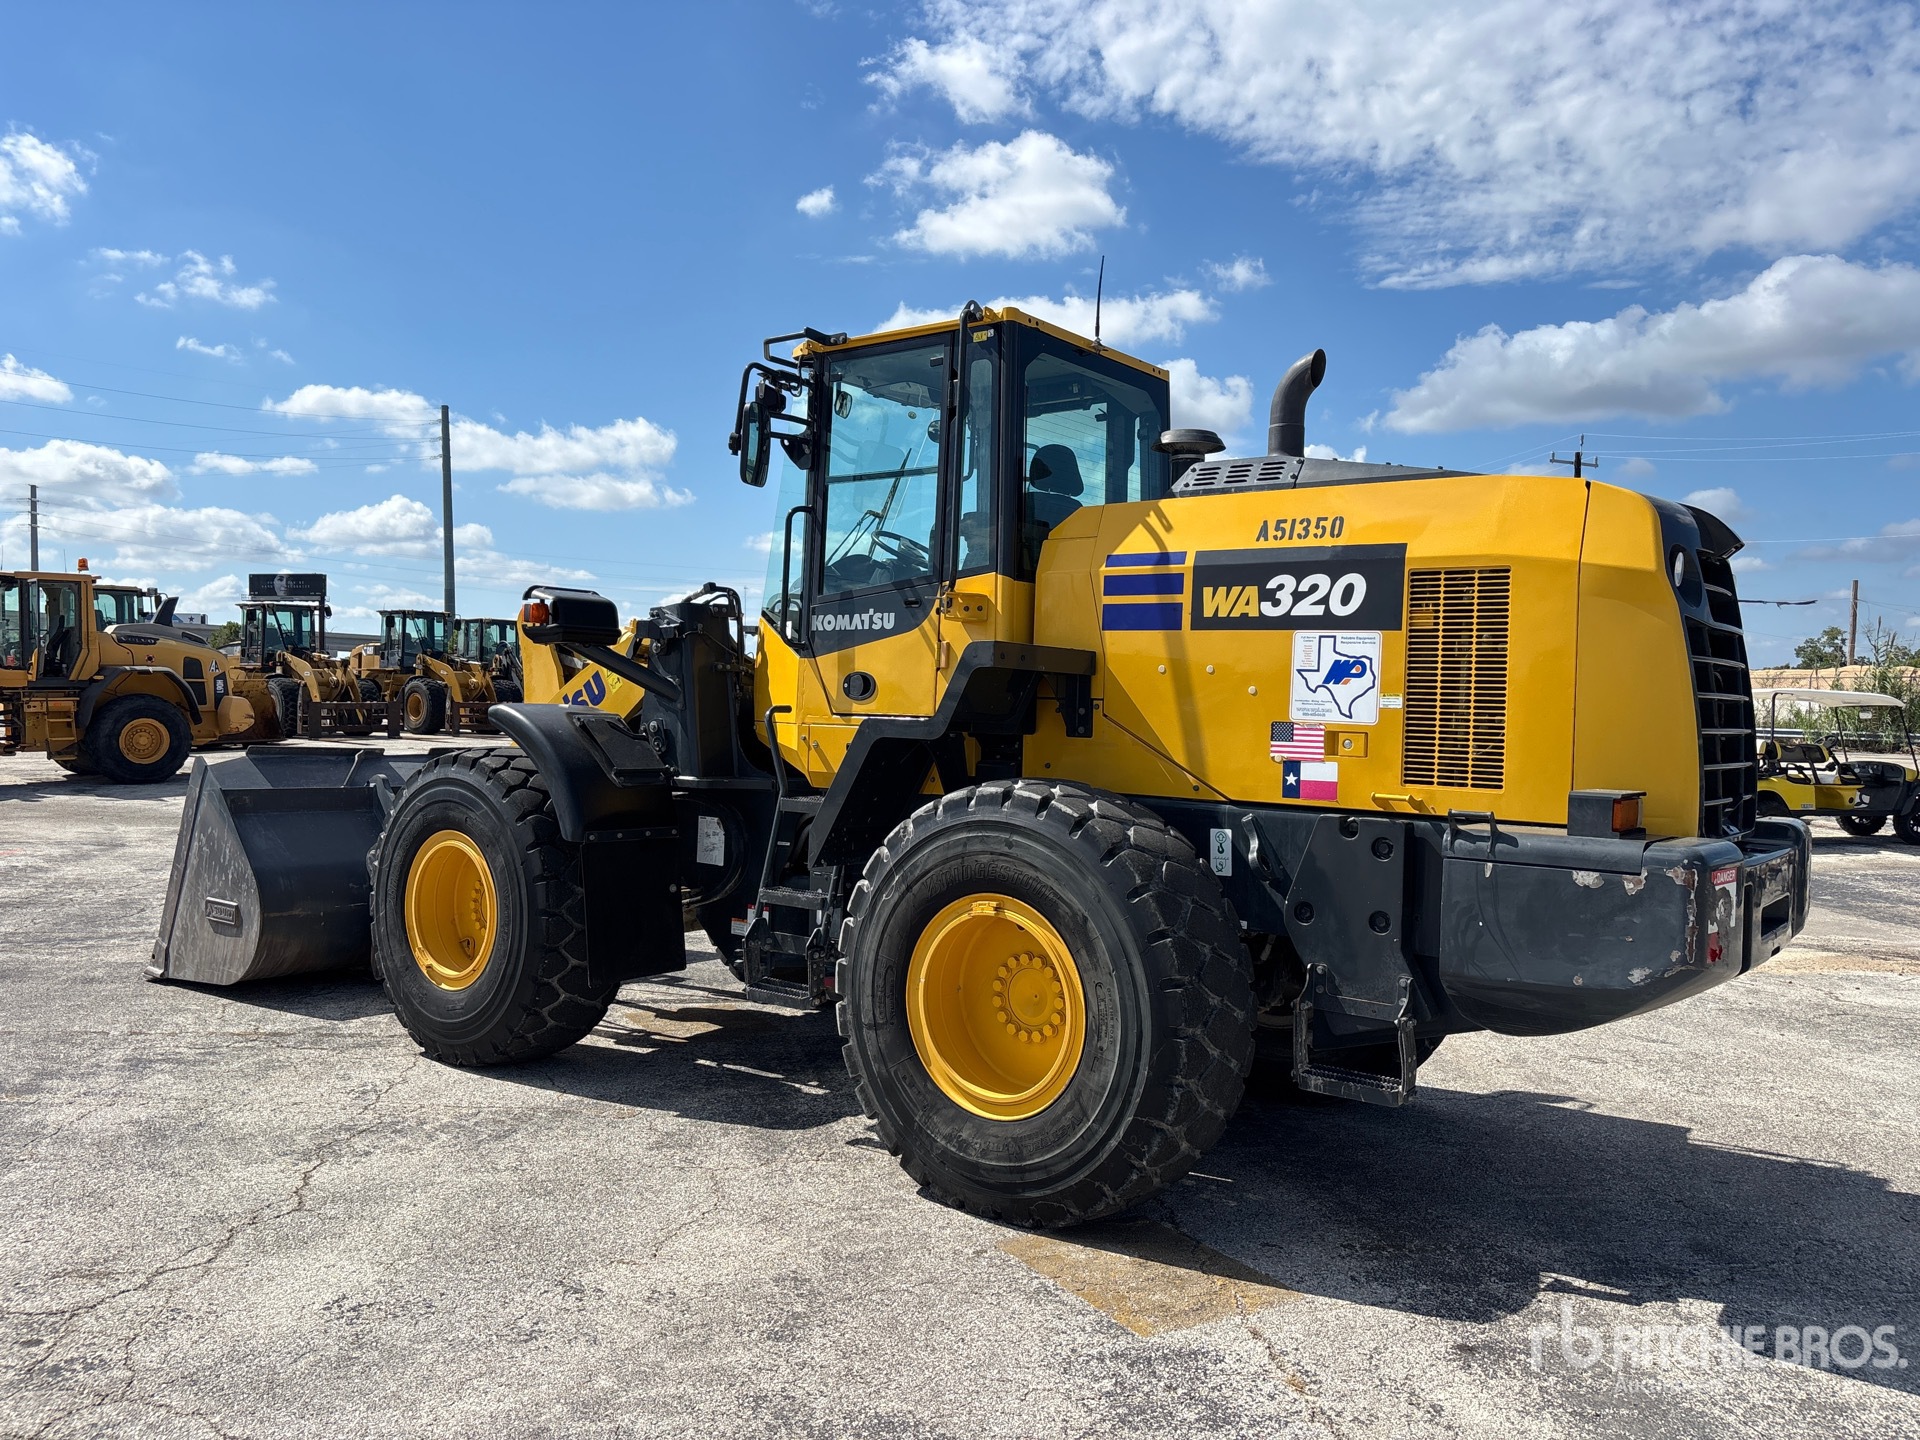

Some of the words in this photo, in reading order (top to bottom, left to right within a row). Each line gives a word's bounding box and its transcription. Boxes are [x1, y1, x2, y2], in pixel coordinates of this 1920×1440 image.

[1256, 516, 1344, 542] A51350
[1203, 573, 1367, 617] WA320
[811, 608, 895, 631] KOMATSU
[923, 862, 1060, 906] BRIDGESTONE
[1716, 869, 1736, 884] DANGER
